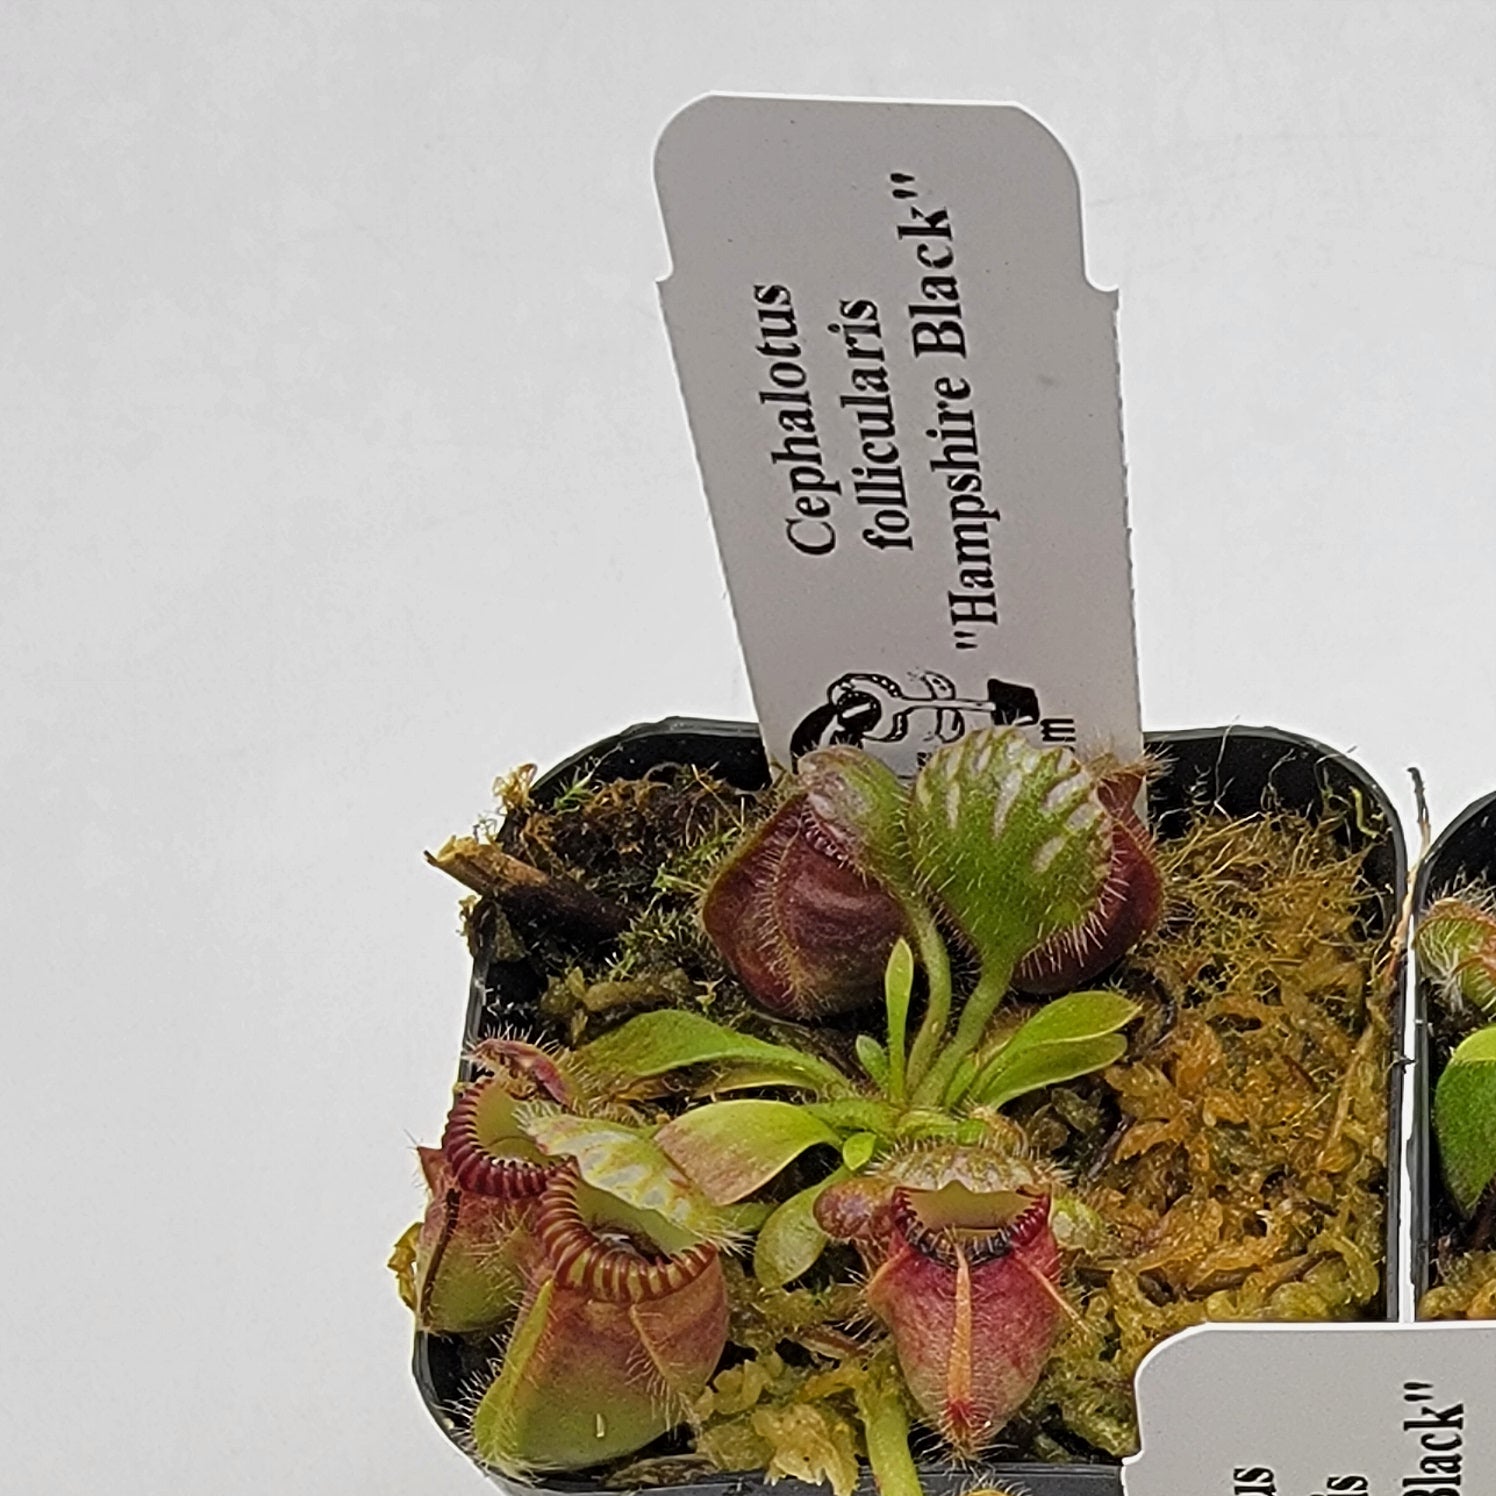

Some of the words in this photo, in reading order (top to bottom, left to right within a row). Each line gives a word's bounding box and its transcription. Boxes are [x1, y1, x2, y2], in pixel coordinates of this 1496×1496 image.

[890, 172, 967, 359] Black"
[753, 284, 843, 556] Cephalotus
[827, 299, 914, 551] follicularis
[925, 376, 1001, 650] "Hampshire
